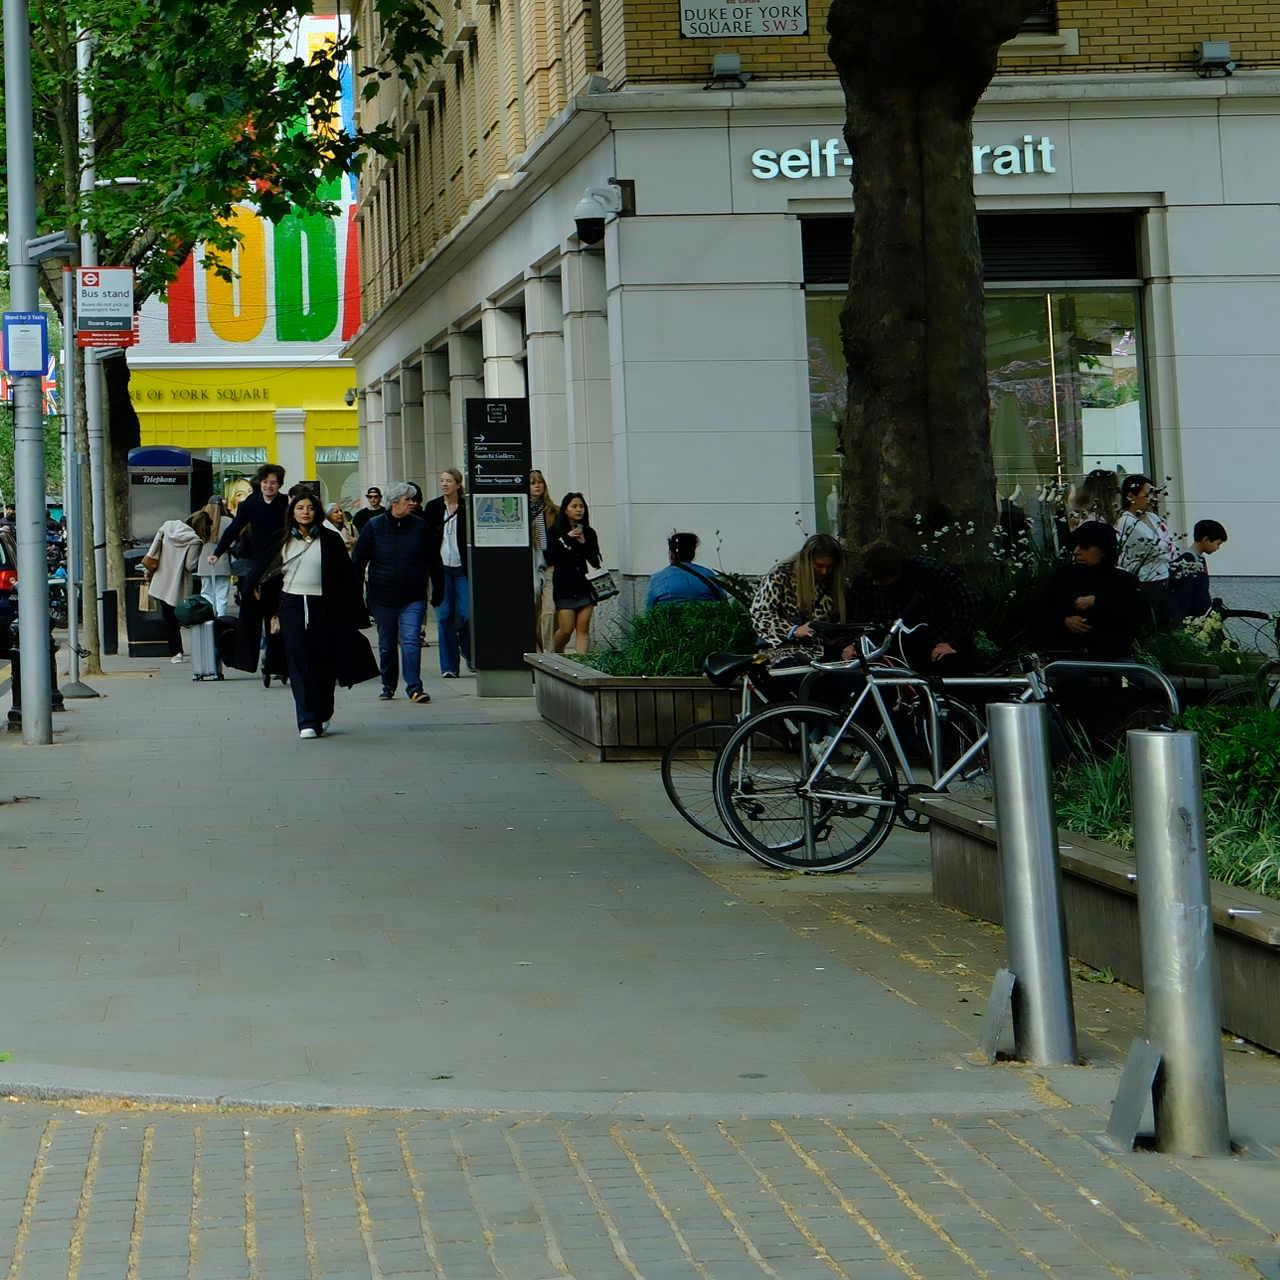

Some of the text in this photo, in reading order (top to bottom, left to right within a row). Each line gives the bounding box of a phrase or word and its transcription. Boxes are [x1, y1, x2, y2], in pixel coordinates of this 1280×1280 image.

[684, 5, 803, 21] DUKE OF YORK
[751, 135, 1057, 179] self-rait
[81, 289, 130, 298] Bus stand
[171, 389, 209, 400] YORK
[216, 387, 270, 402] SQUARE
[143, 475, 177, 485] Telephone
